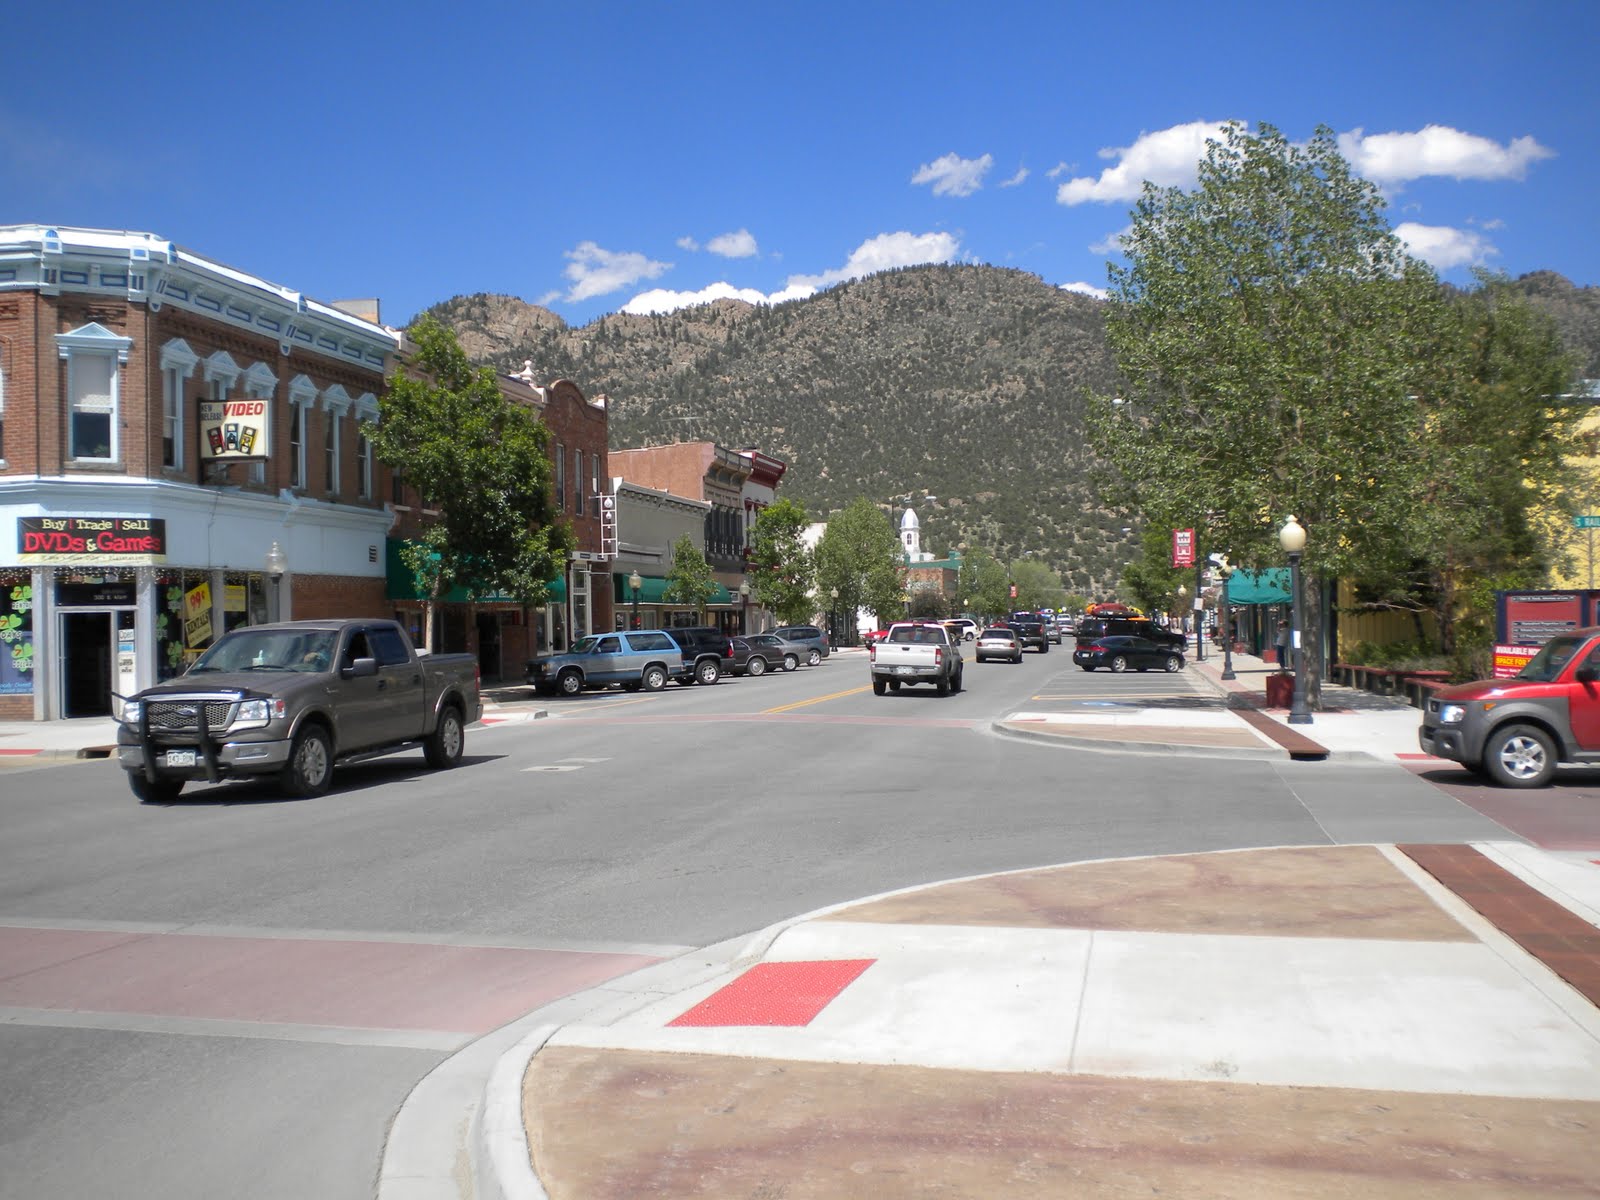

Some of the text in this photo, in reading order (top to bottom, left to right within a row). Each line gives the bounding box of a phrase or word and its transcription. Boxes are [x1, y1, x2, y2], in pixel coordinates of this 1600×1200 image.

[222, 402, 264, 416] VIDEO
[42, 519, 150, 531] Buy Trade Sell
[24, 532, 161, 552] DVDs & Games
[1496, 646, 1528, 655] AVAILABLE
[1496, 657, 1514, 665] SPACE
